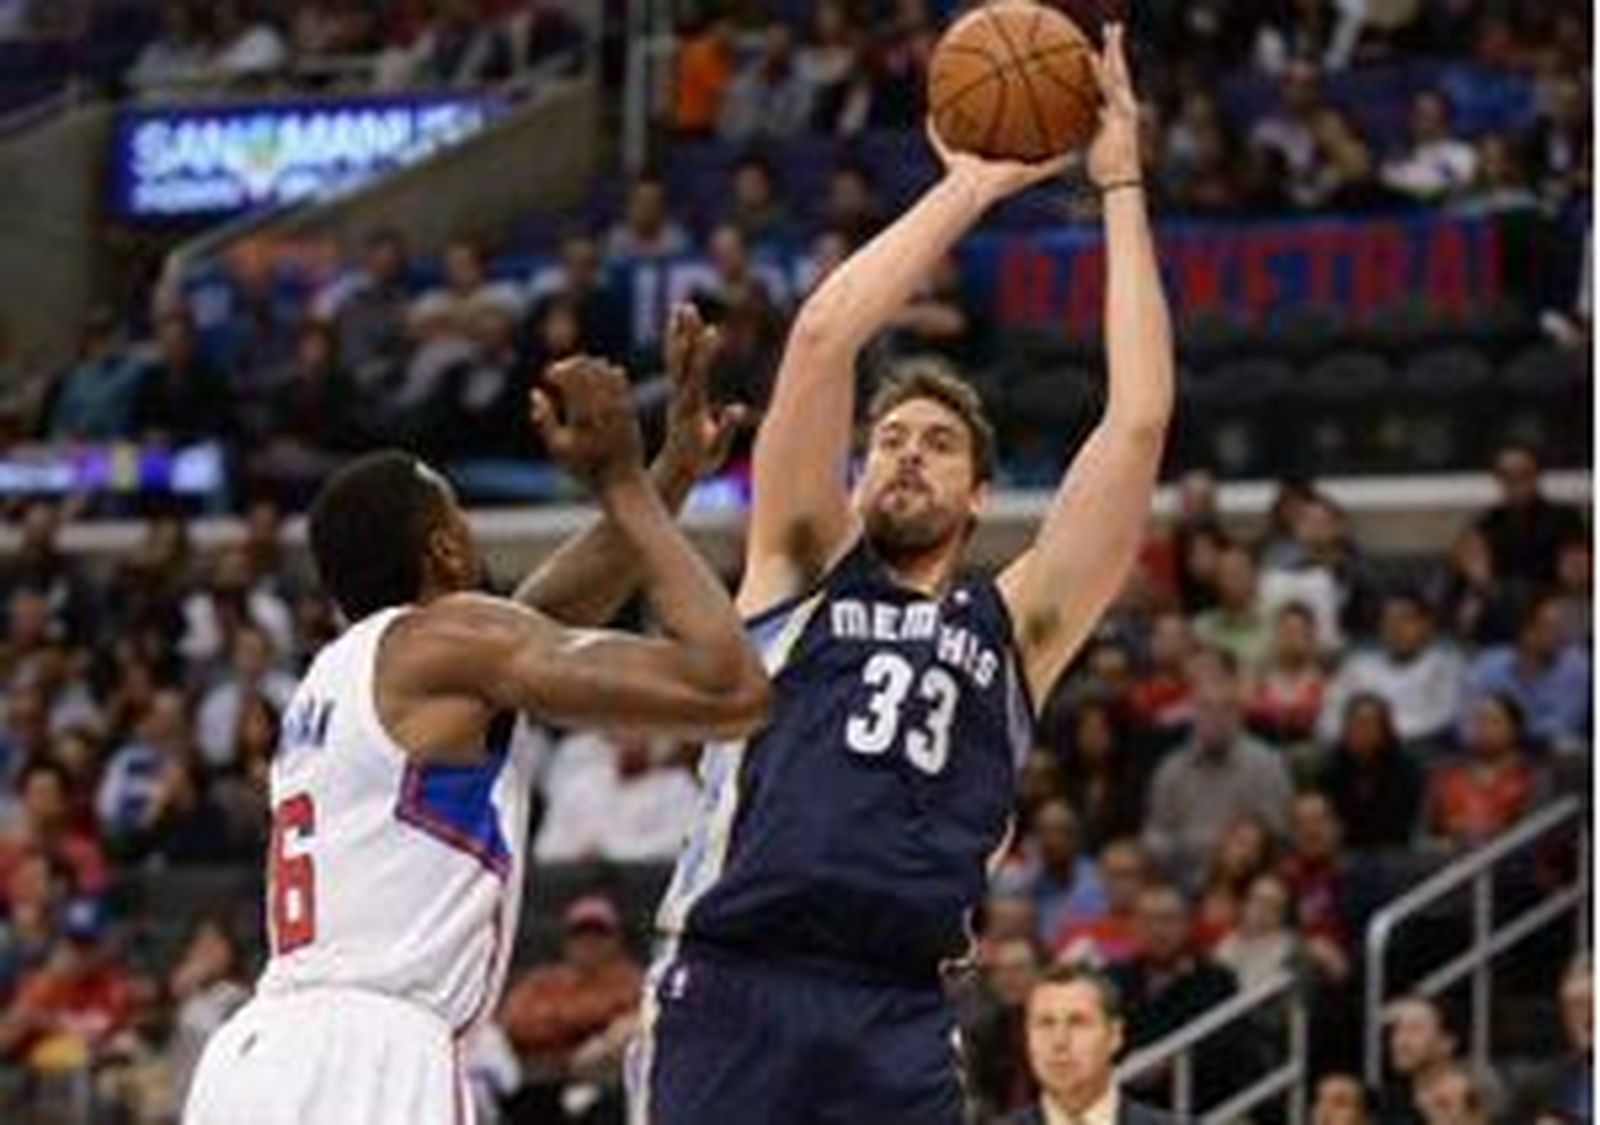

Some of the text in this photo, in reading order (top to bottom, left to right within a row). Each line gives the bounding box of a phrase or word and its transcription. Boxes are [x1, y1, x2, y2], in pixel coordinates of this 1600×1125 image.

[831, 598, 998, 688] MEMHIS
[846, 651, 959, 775] 33
[273, 791, 316, 954] 6
